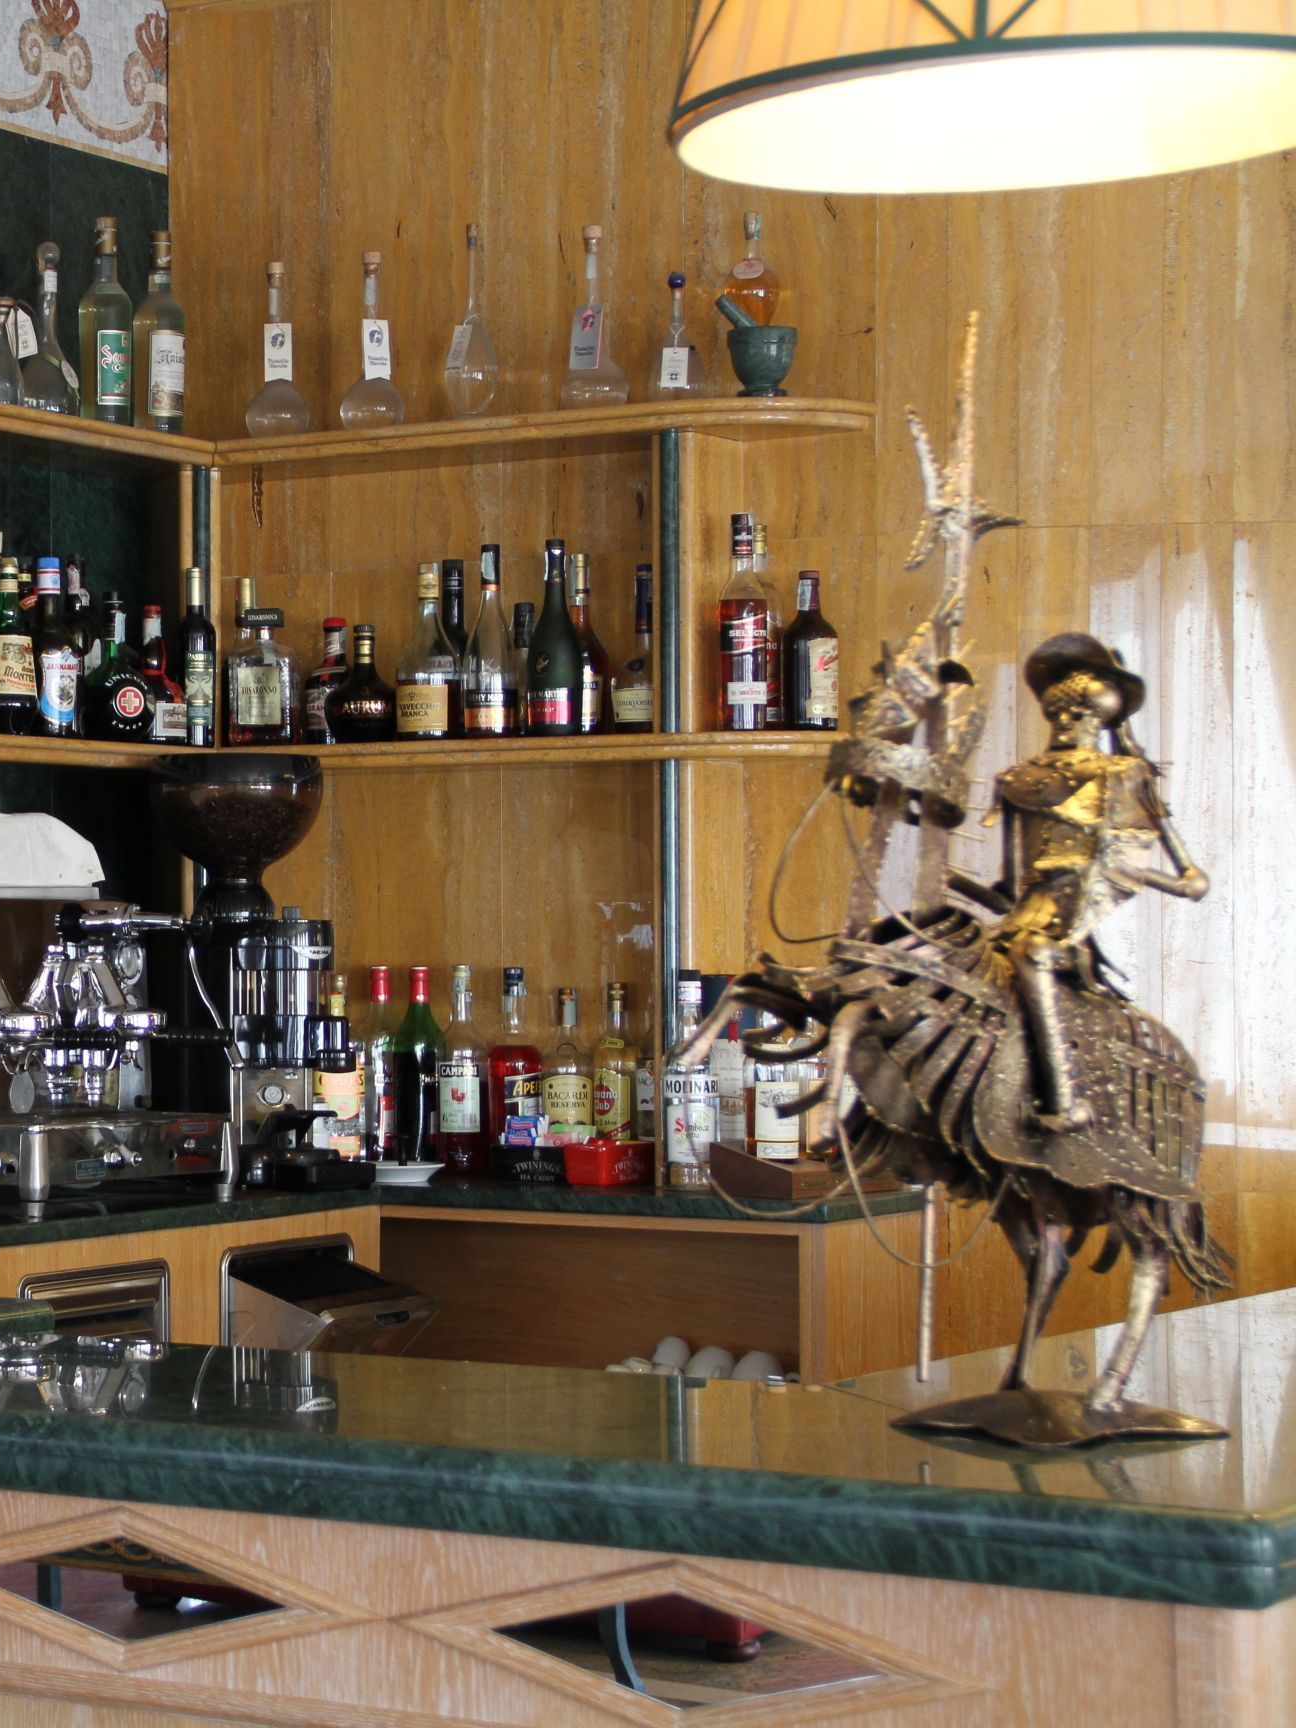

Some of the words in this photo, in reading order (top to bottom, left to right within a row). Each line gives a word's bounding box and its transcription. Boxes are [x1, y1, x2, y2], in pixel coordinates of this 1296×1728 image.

[104, 673, 149, 690] UNICUM
[241, 686, 277, 695] DISARONNO
[341, 700, 392, 715] AURUM
[441, 1066, 479, 1076] CAMPARI
[547, 1091, 589, 1100] BACARDI
[674, 1116, 710, 1134] Smbua
[514, 1161, 561, 1174] TWININGS
